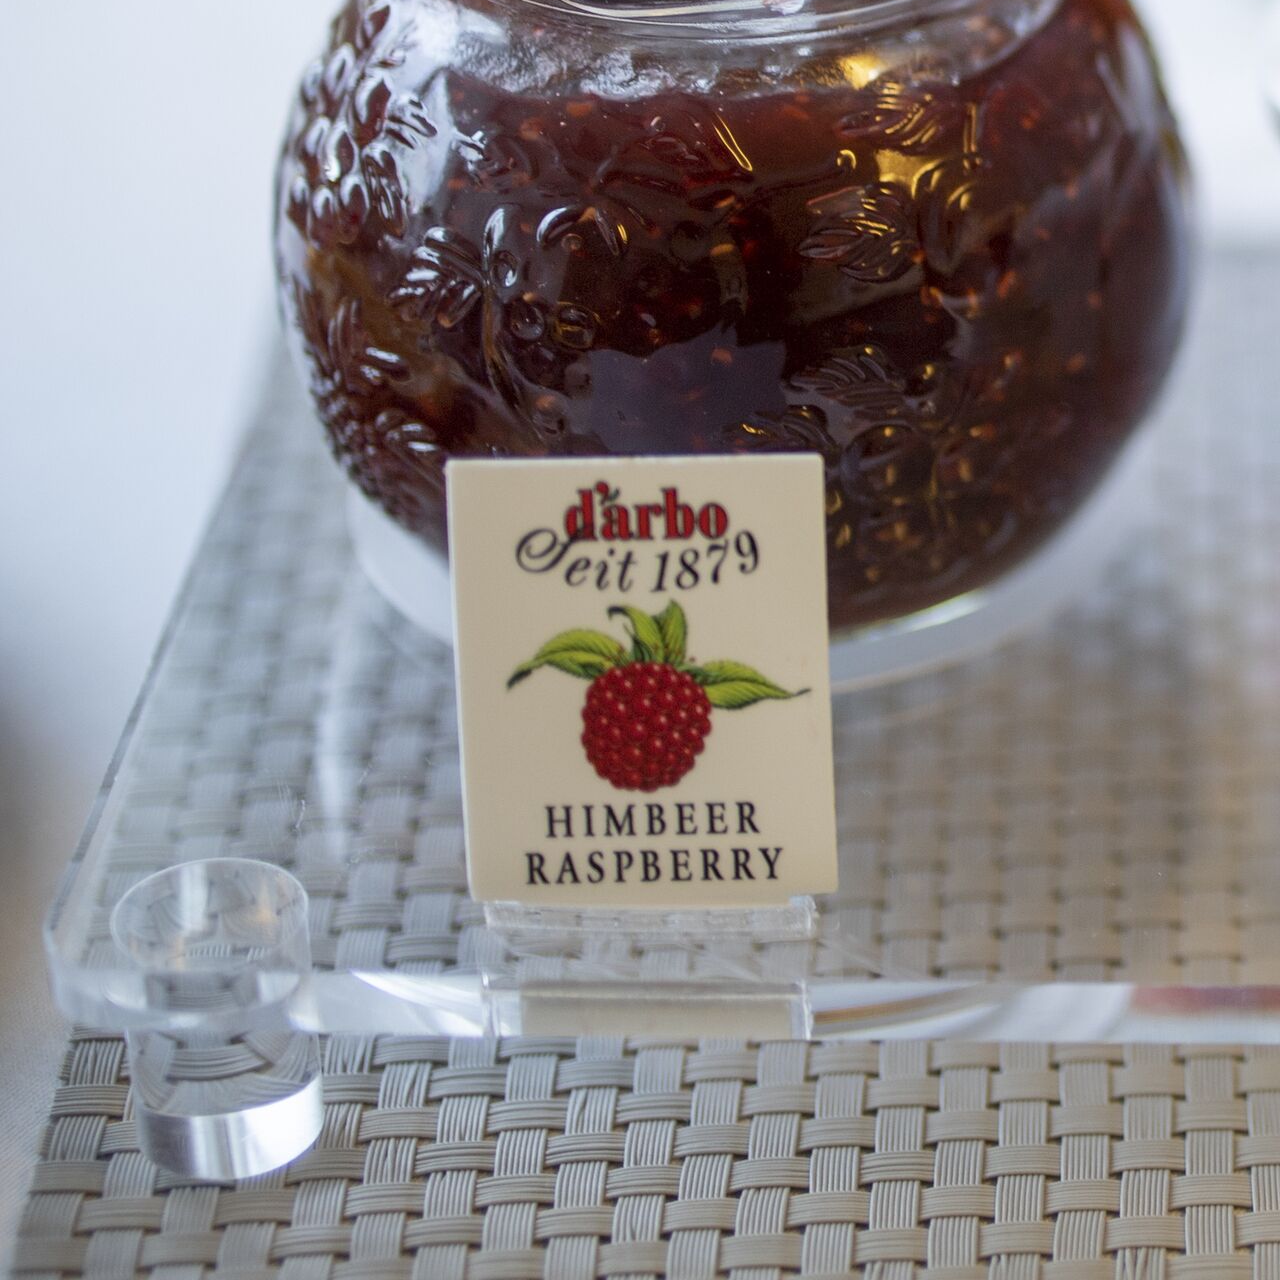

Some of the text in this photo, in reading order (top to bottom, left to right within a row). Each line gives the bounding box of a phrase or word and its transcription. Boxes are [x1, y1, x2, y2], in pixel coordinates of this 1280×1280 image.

[515, 528, 760, 593] Seit 1879
[545, 801, 761, 838] HIMBEER
[525, 847, 784, 885] RASPBERRY
